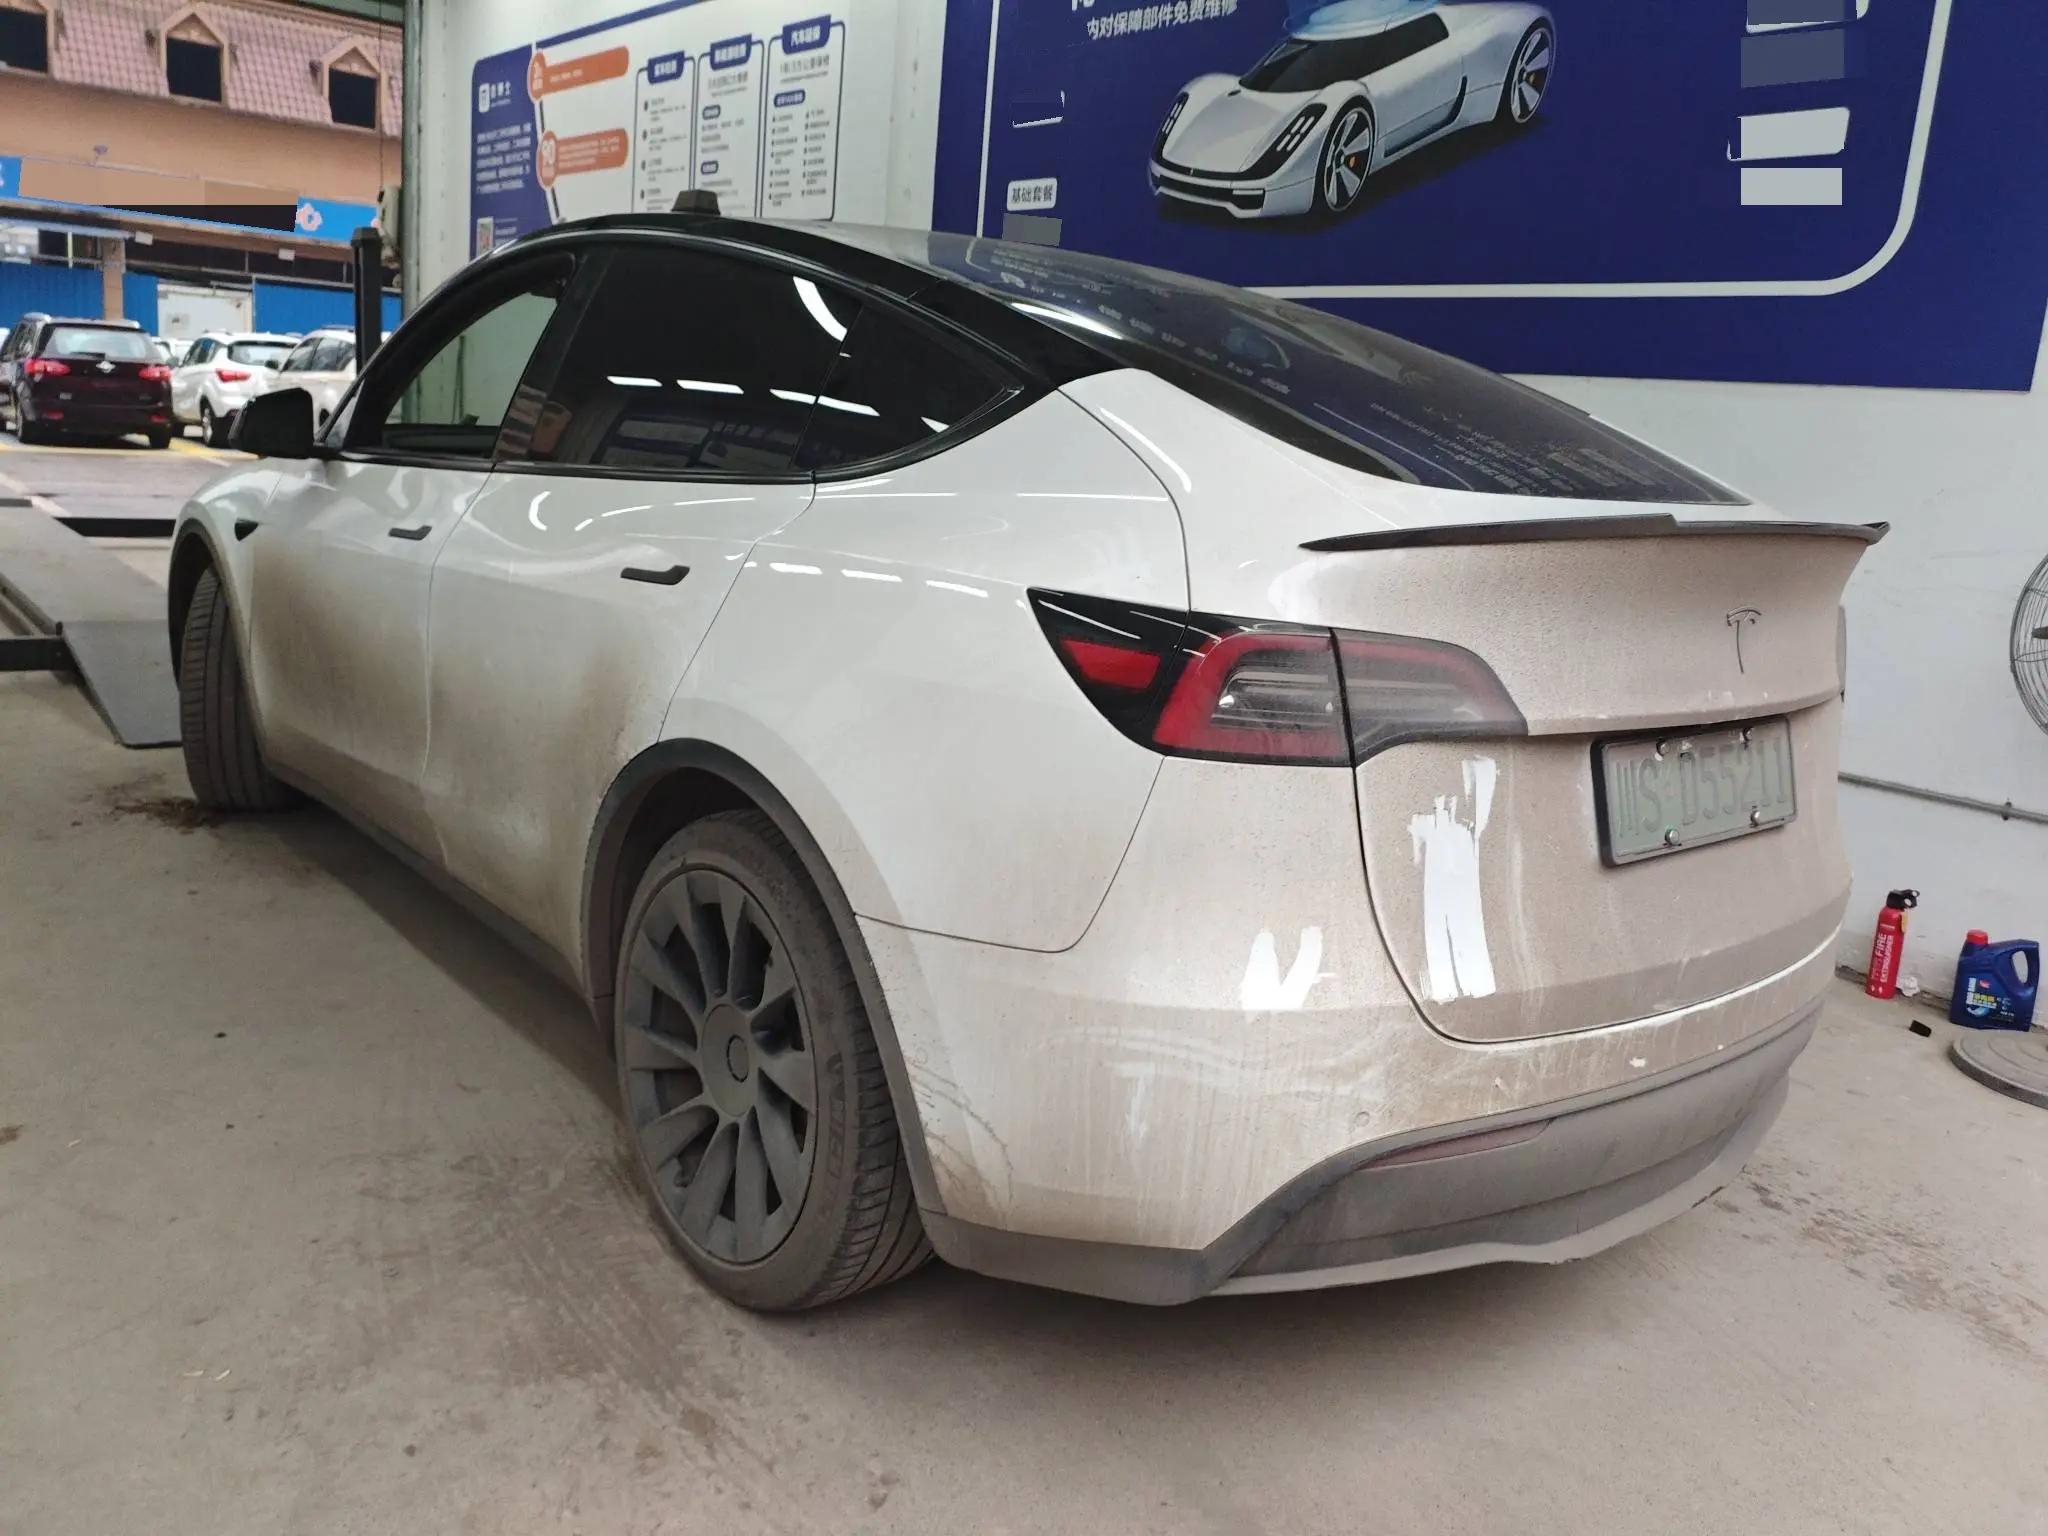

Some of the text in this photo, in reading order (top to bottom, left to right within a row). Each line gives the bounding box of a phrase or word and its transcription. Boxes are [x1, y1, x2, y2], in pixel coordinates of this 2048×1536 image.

[1086, 0, 1238, 40] 内对保障部件免费维修
[1875, 933, 1887, 957] FIRE
